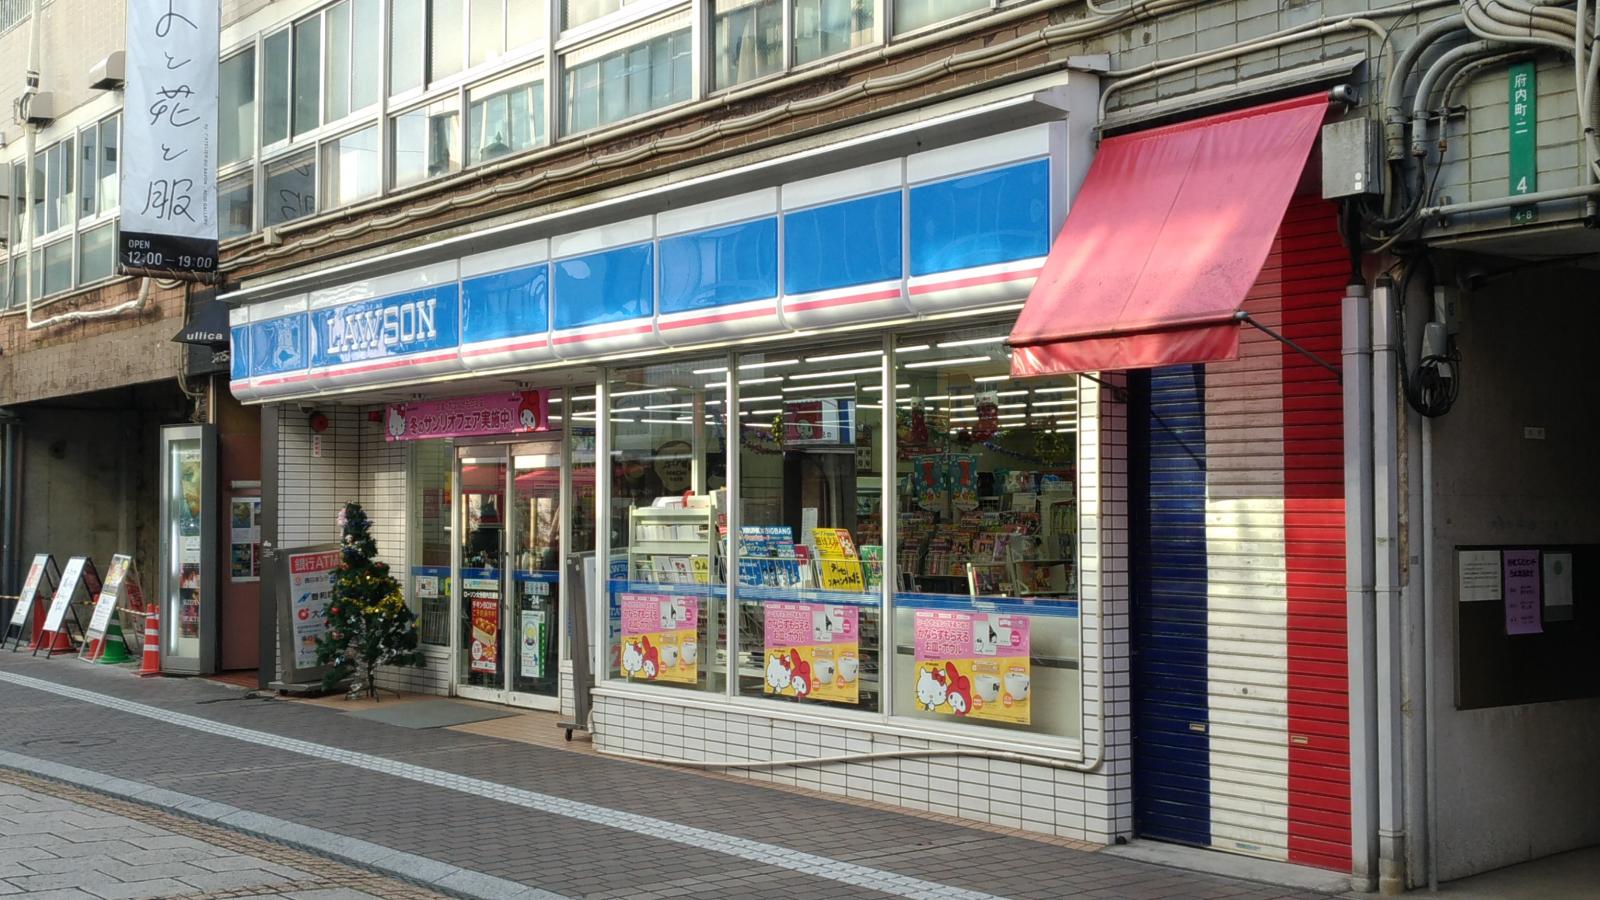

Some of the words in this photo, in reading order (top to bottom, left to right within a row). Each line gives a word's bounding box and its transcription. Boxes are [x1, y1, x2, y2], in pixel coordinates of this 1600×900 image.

[1516, 176, 1528, 194] 4
[128, 239, 151, 249] OPEN
[127, 251, 163, 266] 12:00
[178, 255, 212, 269] 19:00
[327, 298, 437, 354] LAWSON
[918, 629, 970, 643] かならずもらえる
